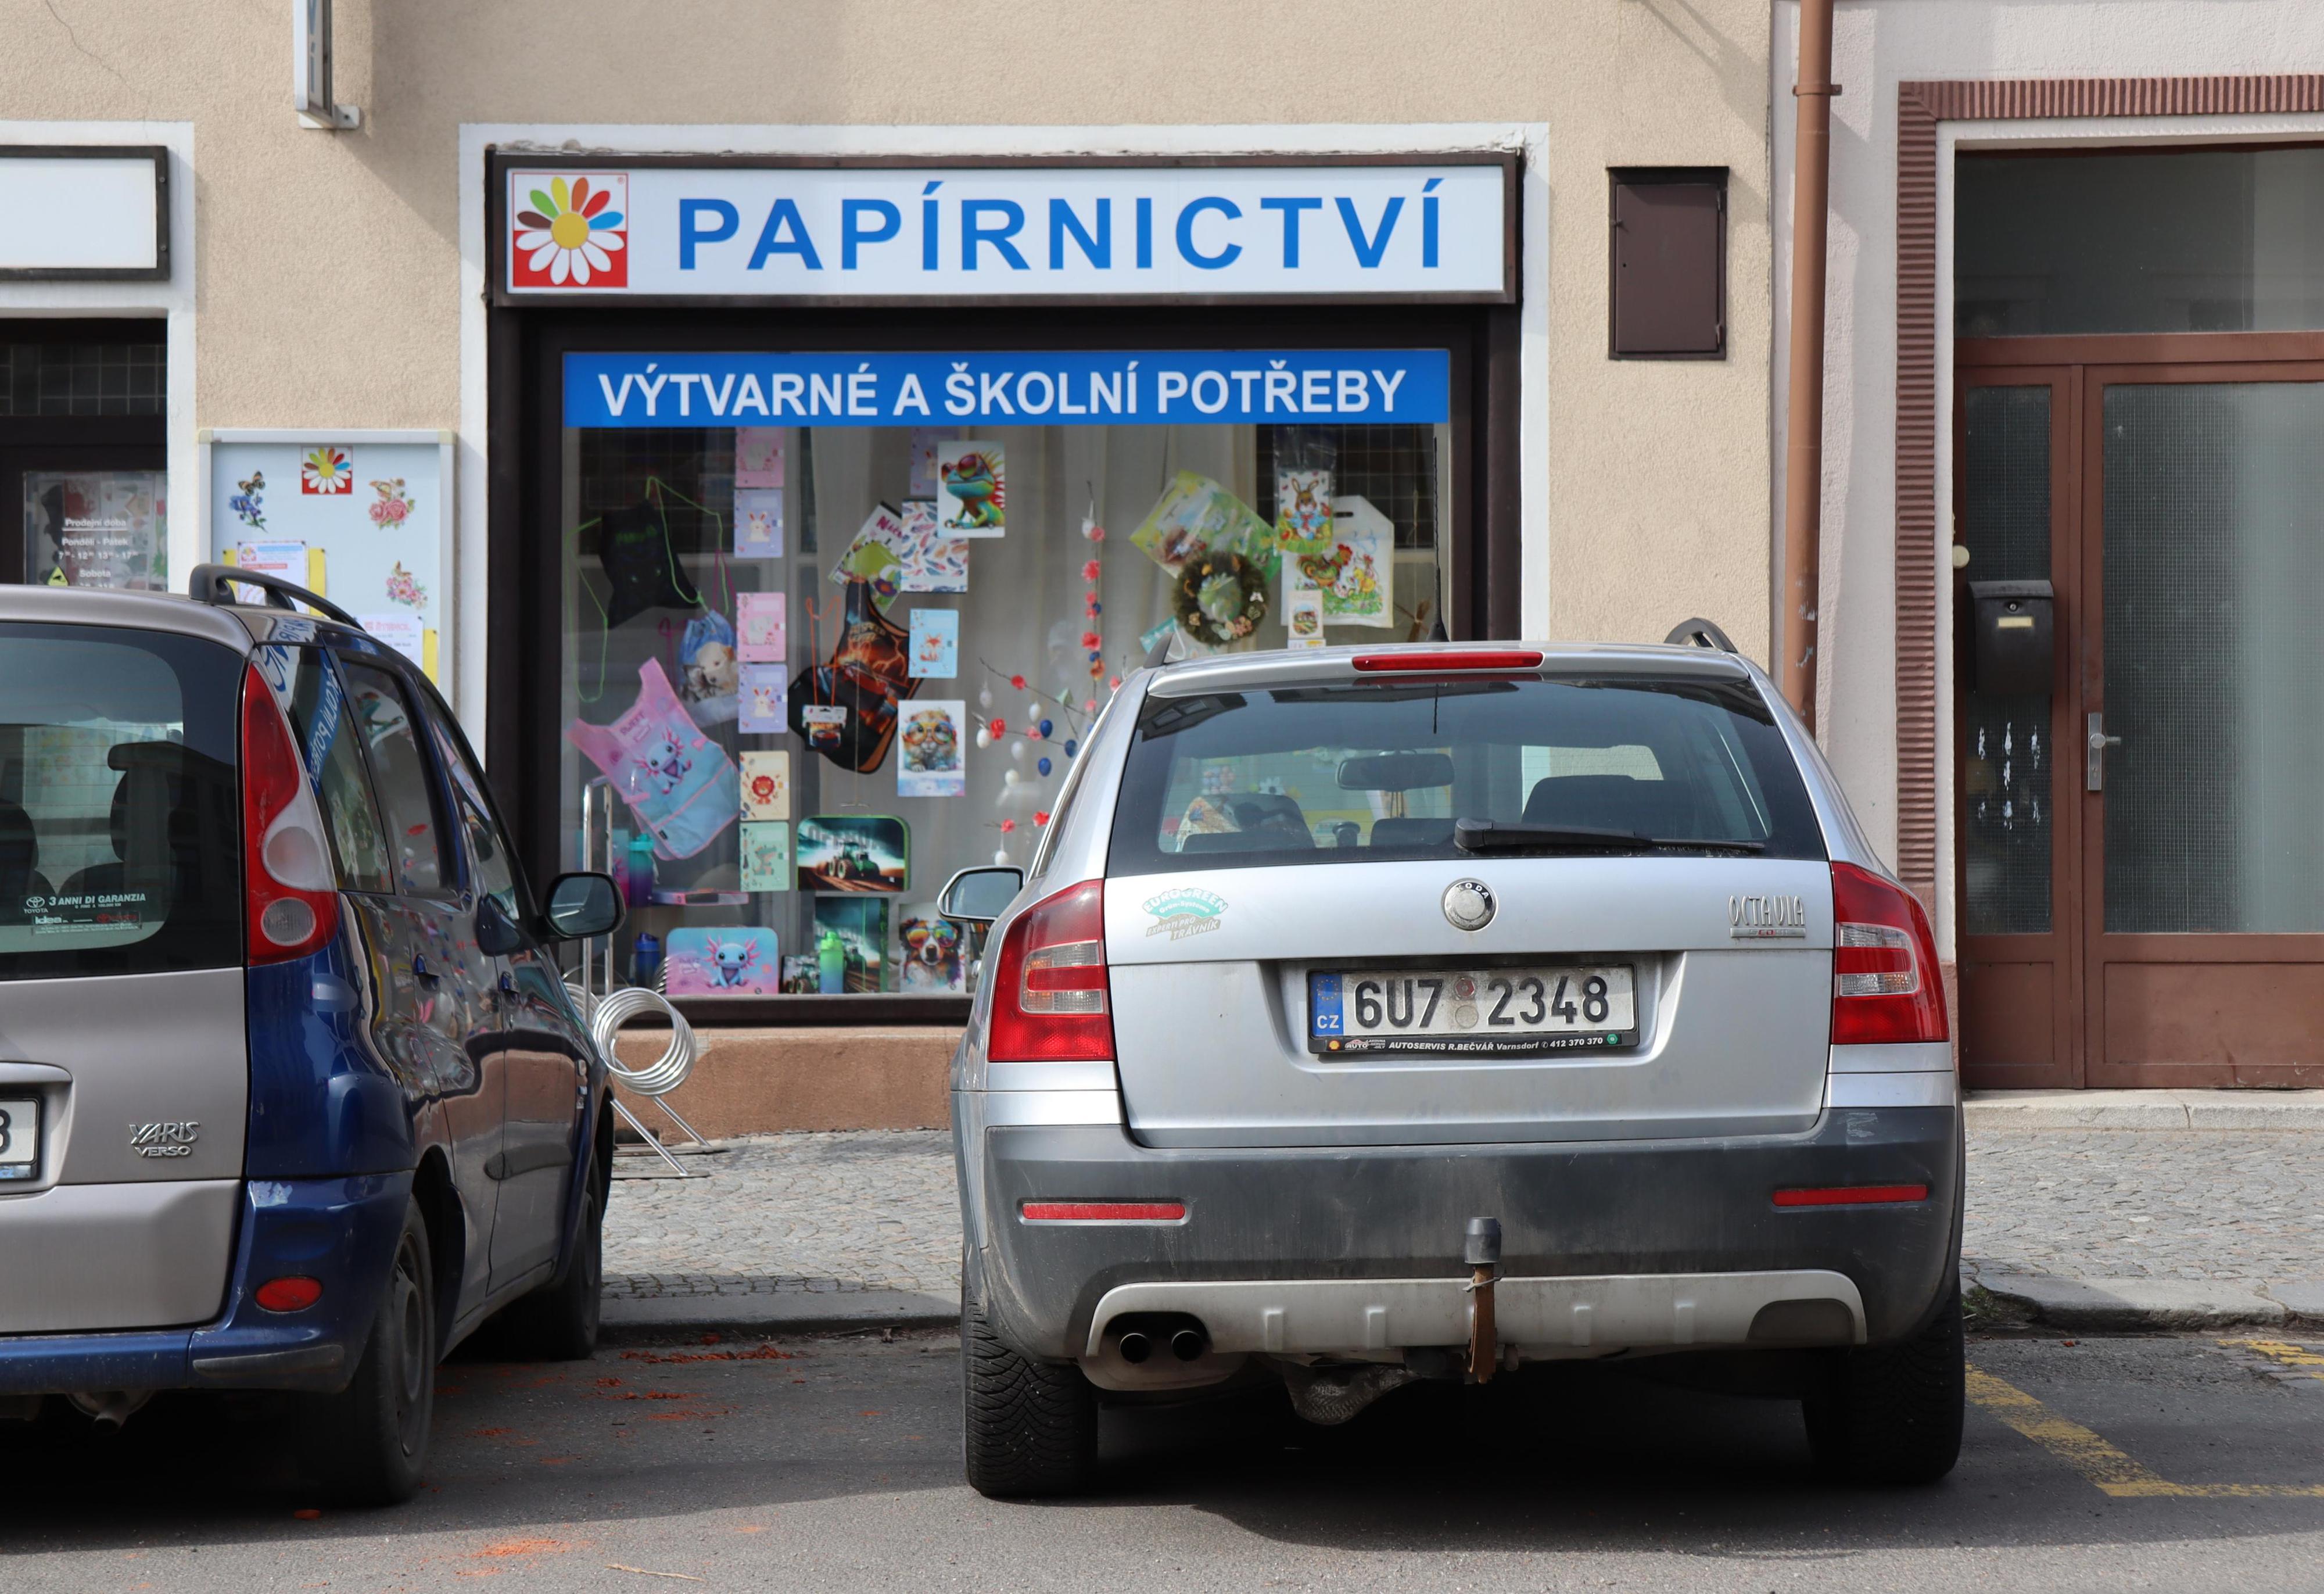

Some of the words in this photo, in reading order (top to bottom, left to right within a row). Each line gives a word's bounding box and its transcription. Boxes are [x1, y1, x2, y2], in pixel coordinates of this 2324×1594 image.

[679, 178, 1444, 271] PAPÍRNICTVÍ
[598, 363, 878, 417] VÝTVARNÉ
[892, 373, 931, 417] A
[944, 361, 1139, 415] ŠKOLNÍ
[1157, 360, 1407, 414] POTŘEBY
[65, 518, 102, 528] Prodejní
[105, 518, 127, 526] doba
[79, 568, 111, 578] Sobota
[49, 896, 56, 906] 3
[58, 896, 82, 905] ANNI
[84, 895, 95, 904] DI
[98, 893, 146, 903] GARANZIA
[1143, 888, 1228, 913] EUROGREEN
[1728, 895, 1806, 926] OCTAVIA
[1179, 916, 1196, 927] PRO
[1172, 919, 1219, 940] TRÁVNÍK
[1355, 978, 1444, 1029] 6U7
[1487, 976, 1608, 1026] 2348
[1317, 1015, 1339, 1029] CZ
[1389, 1041, 1446, 1051] AUTOSERVIS
[1497, 1041, 1539, 1051] Varnsdorf
[1550, 1037, 1566, 1047] 412
[1569, 1037, 1585, 1047] 370
[1587, 1037, 1604, 1045] 370
[134, 1145, 192, 1158] VERSO
